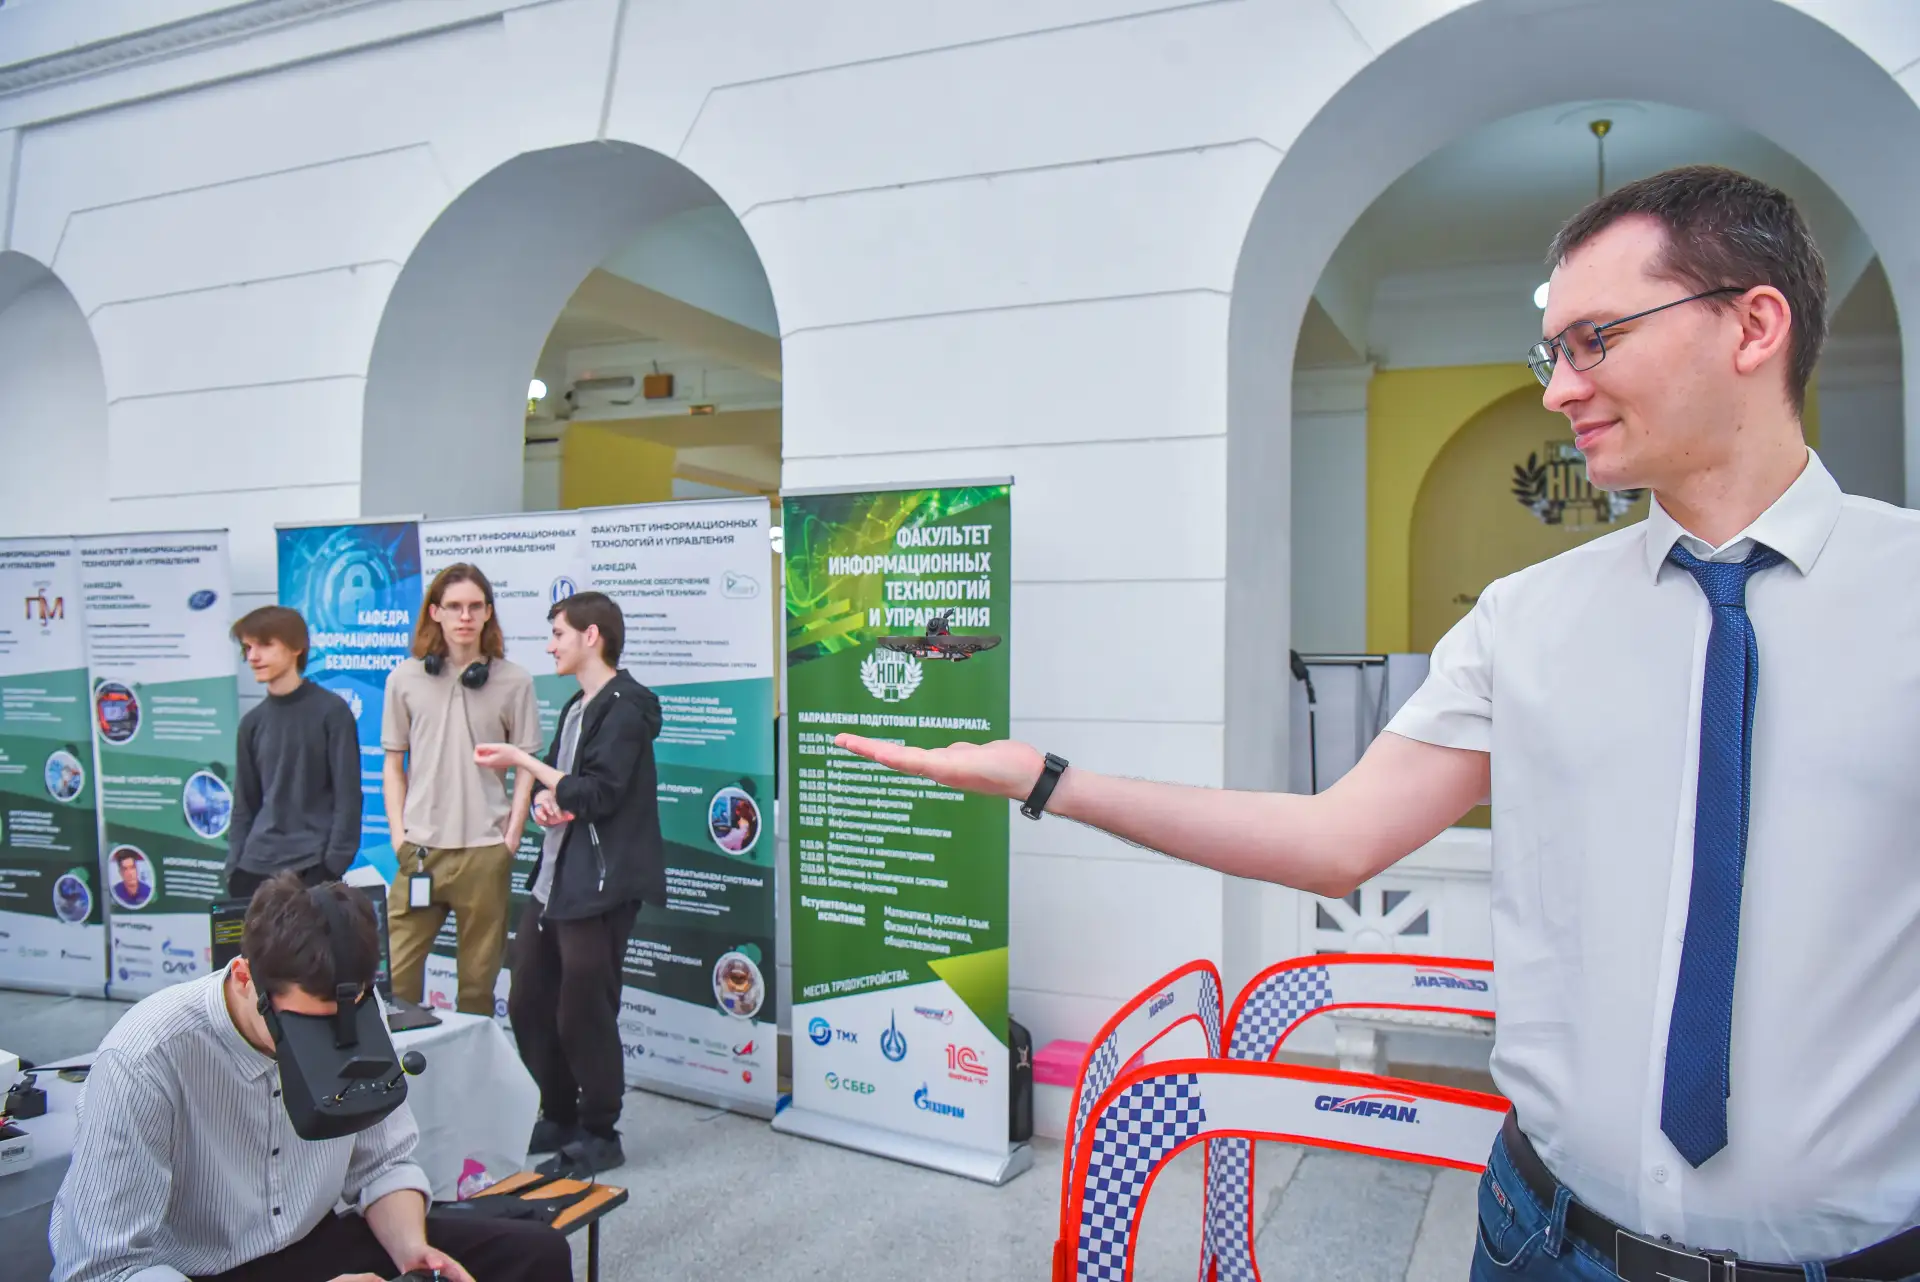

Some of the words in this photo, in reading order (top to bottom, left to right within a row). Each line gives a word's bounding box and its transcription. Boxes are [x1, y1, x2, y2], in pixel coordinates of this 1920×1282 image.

[591, 523, 646, 534] ФАКУЛЬТЕТ
[648, 519, 758, 532] ИНФОРМАЦИОННЫХ
[426, 534, 477, 544] ФАКУЛЬТЕТ
[478, 529, 576, 542] ИНФОРМАЦИОННЫХ
[590, 537, 654, 549] ТЕХНОЛОГИЙ
[656, 538, 664, 546] И
[664, 535, 734, 546] УПРАВЛЕНИЯ
[896, 524, 992, 548] ФАКУЛЬТЕТ
[426, 545, 484, 557] ТЕХНОЛОГИЙ
[494, 543, 556, 554] УПРАВЛЕНИЯ
[591, 563, 637, 572] КАФЕДРА
[828, 552, 991, 576] ИНФОРМАЦИОННЫХ
[654, 578, 710, 586] ОБЕСПЕЧЕНИЕ
[885, 575, 990, 600] ТЕХНОЛОГИЙ
[358, 610, 410, 627] КАФЕДРА
[868, 608, 880, 626] И
[311, 631, 409, 648] НФОРМАЦИОННАЯ
[325, 654, 405, 670] БЕЗОПАСНОСТ
[798, 712, 858, 724] НАПРАВЛЕНИЯ
[860, 714, 917, 727] ПОДГОТОВКИ
[919, 716, 990, 730] БАКАЛАВРИАТА:
[722, 874, 764, 887] СИСТЕМЫ
[934, 914, 967, 928] русский
[968, 918, 990, 930] язык
[803, 981, 830, 998] МЕСТА
[832, 969, 910, 992] ТРУДОУСТРОЙСТВА:
[836, 1028, 858, 1044] ТМХ
[945, 1044, 988, 1076] 1С
[842, 1078, 876, 1094] СБЕР
[1315, 1095, 1417, 1123] GEMFAN
